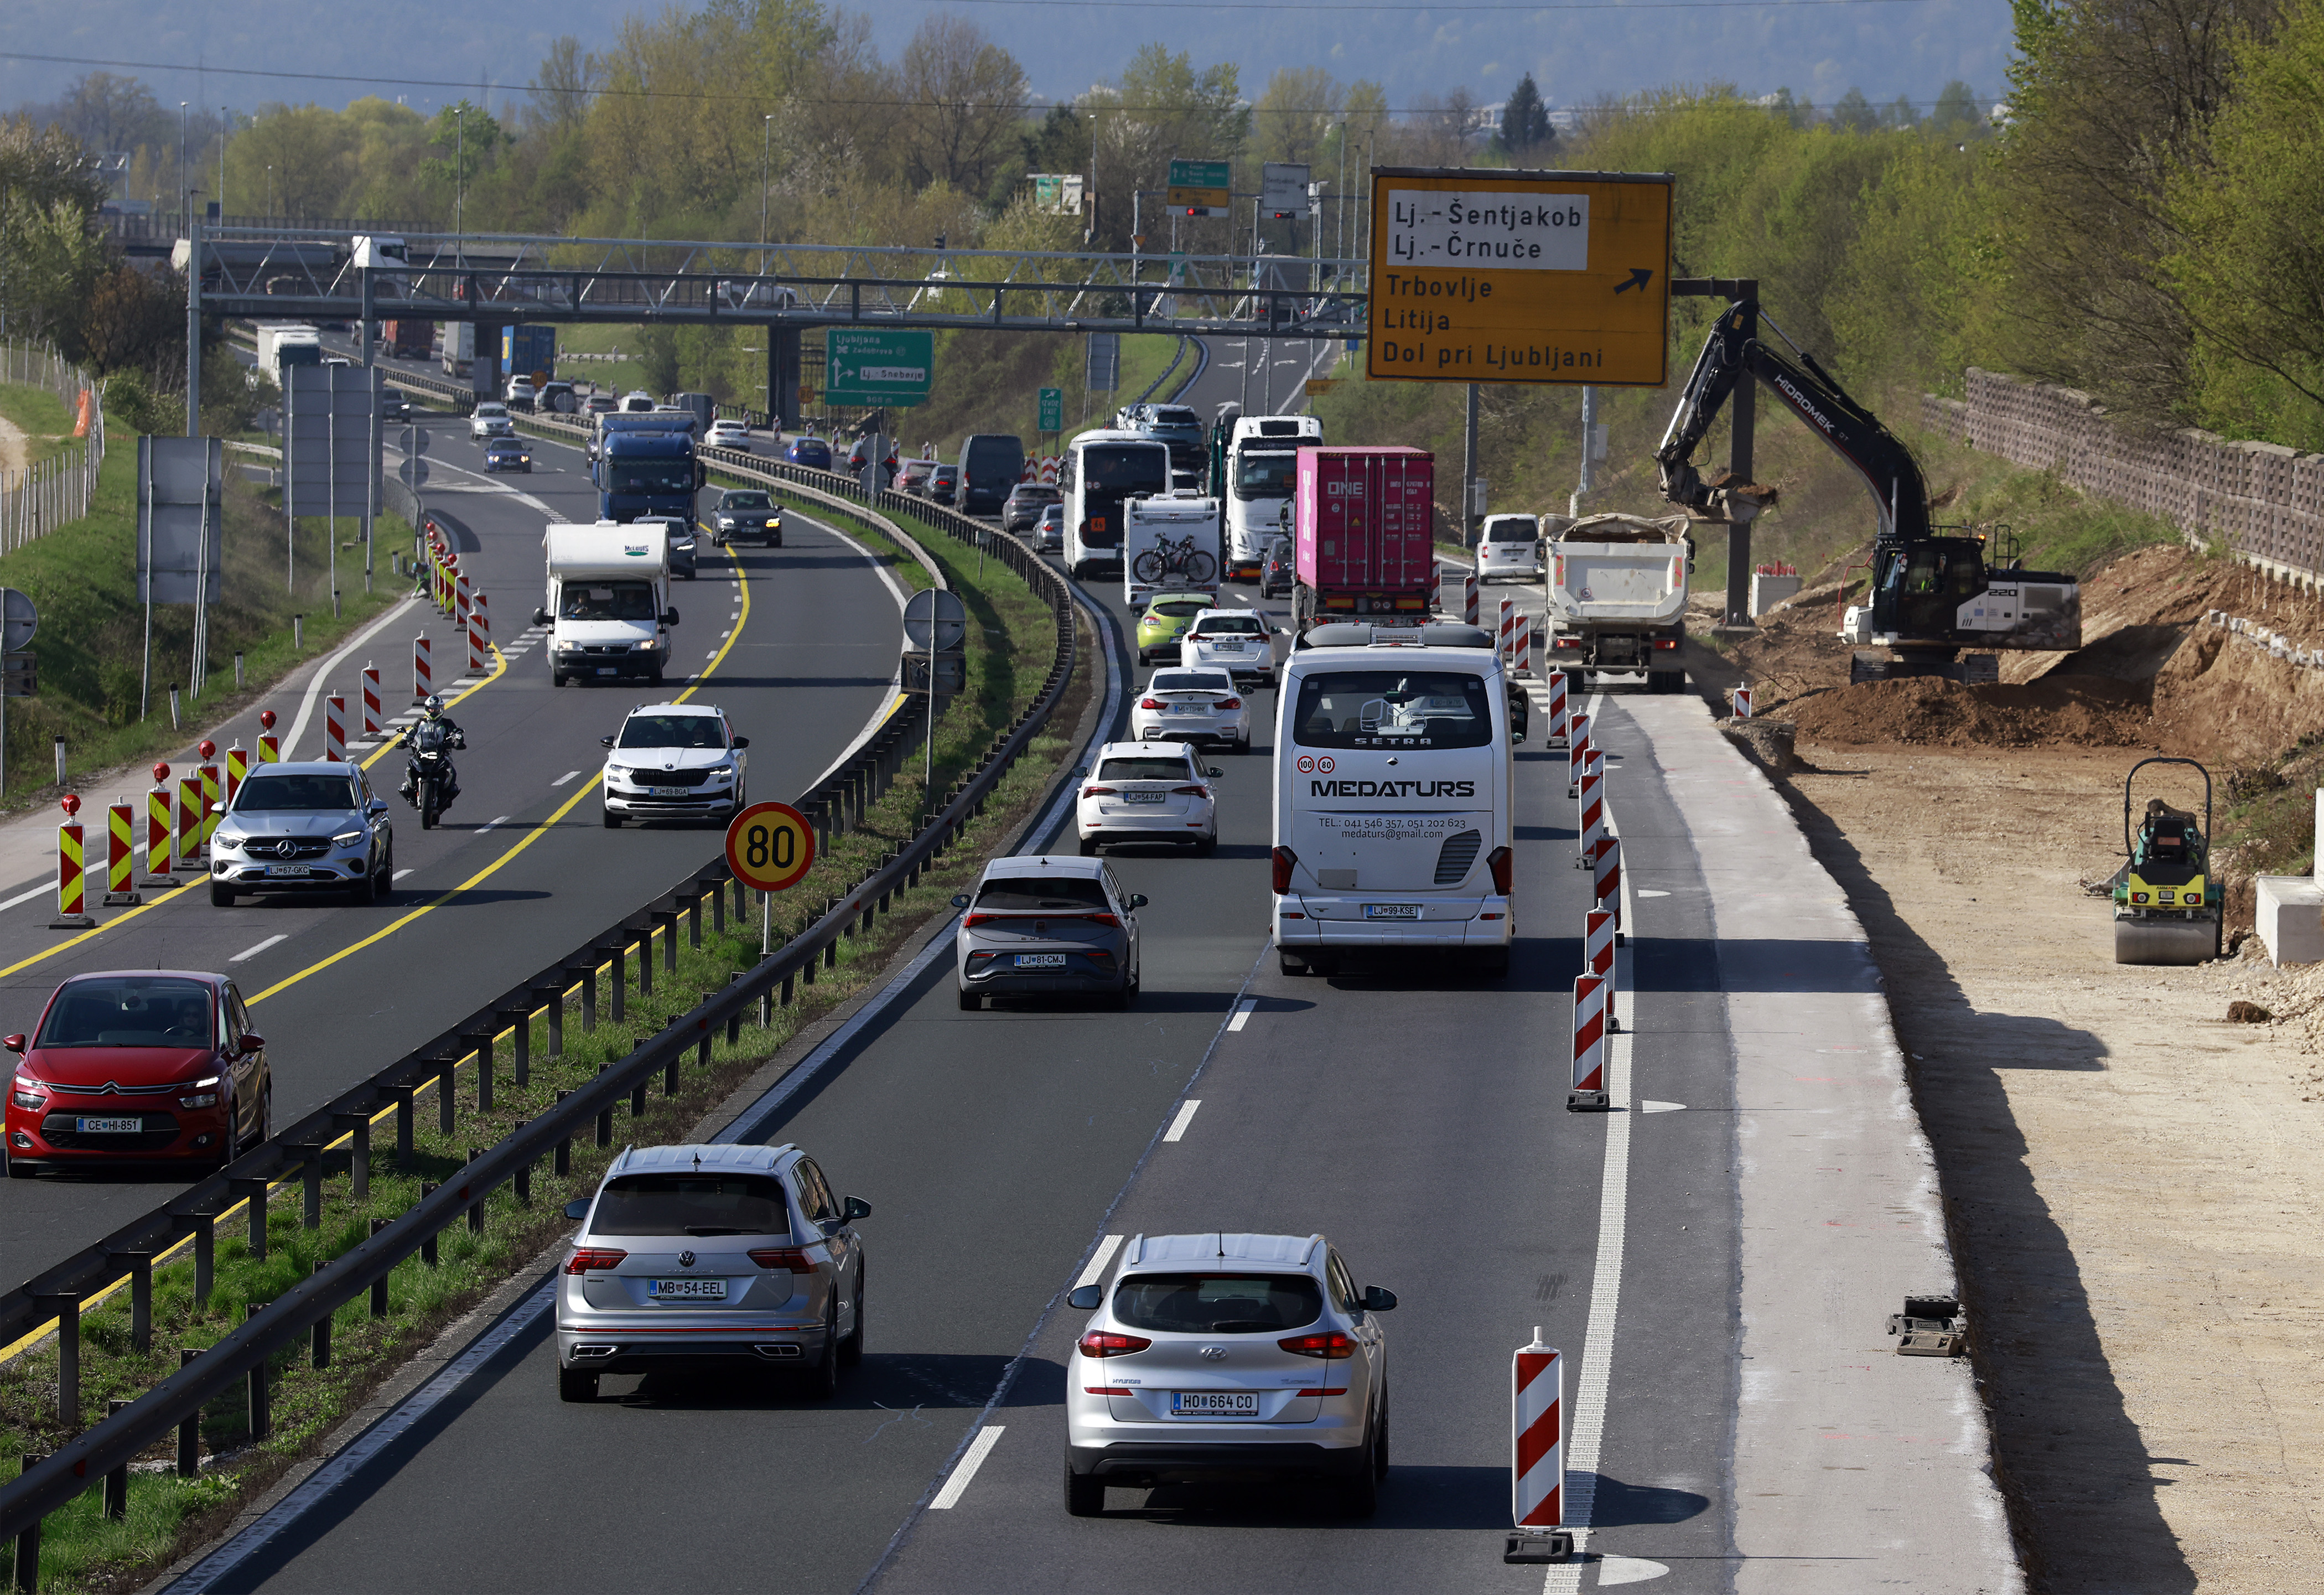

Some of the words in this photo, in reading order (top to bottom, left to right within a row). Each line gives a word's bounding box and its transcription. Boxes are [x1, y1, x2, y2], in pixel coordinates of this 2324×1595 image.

[1386, 275, 1492, 302] Trbovlje
[1384, 308, 1450, 335] Litija
[836, 334, 880, 345] Ljubljana
[1383, 341, 1424, 363] Dol
[1439, 345, 1472, 369] pri
[1486, 344, 1602, 371] Ljubljani
[1327, 481, 1363, 495] ONE
[1988, 588, 2017, 597] 220
[1300, 760, 1312, 769] 100
[1310, 780, 1475, 798] MEDATURS
[1319, 818, 1341, 827] TEL.:
[1344, 819, 1361, 828] 041
[1365, 818, 1382, 828] 546
[1385, 819, 1404, 829] 357,
[1407, 819, 1424, 827] 051
[1428, 819, 1445, 827] 202
[1448, 818, 1466, 828] 623
[1341, 829, 1443, 840] medaturs@gmail.com
[746, 825, 795, 869] 80
[1388, 907, 1414, 915] 99-KSE
[1021, 956, 1031, 964] LJ
[1037, 955, 1064, 964] 81-CMJ
[89, 1120, 101, 1130] CE
[108, 1120, 137, 1130] HI-851
[658, 1281, 675, 1294] MB
[684, 1282, 724, 1294] 54-EEL
[1184, 1395, 1200, 1408] HO
[1210, 1395, 1233, 1408] 664
[1237, 1395, 1252, 1408] CO
